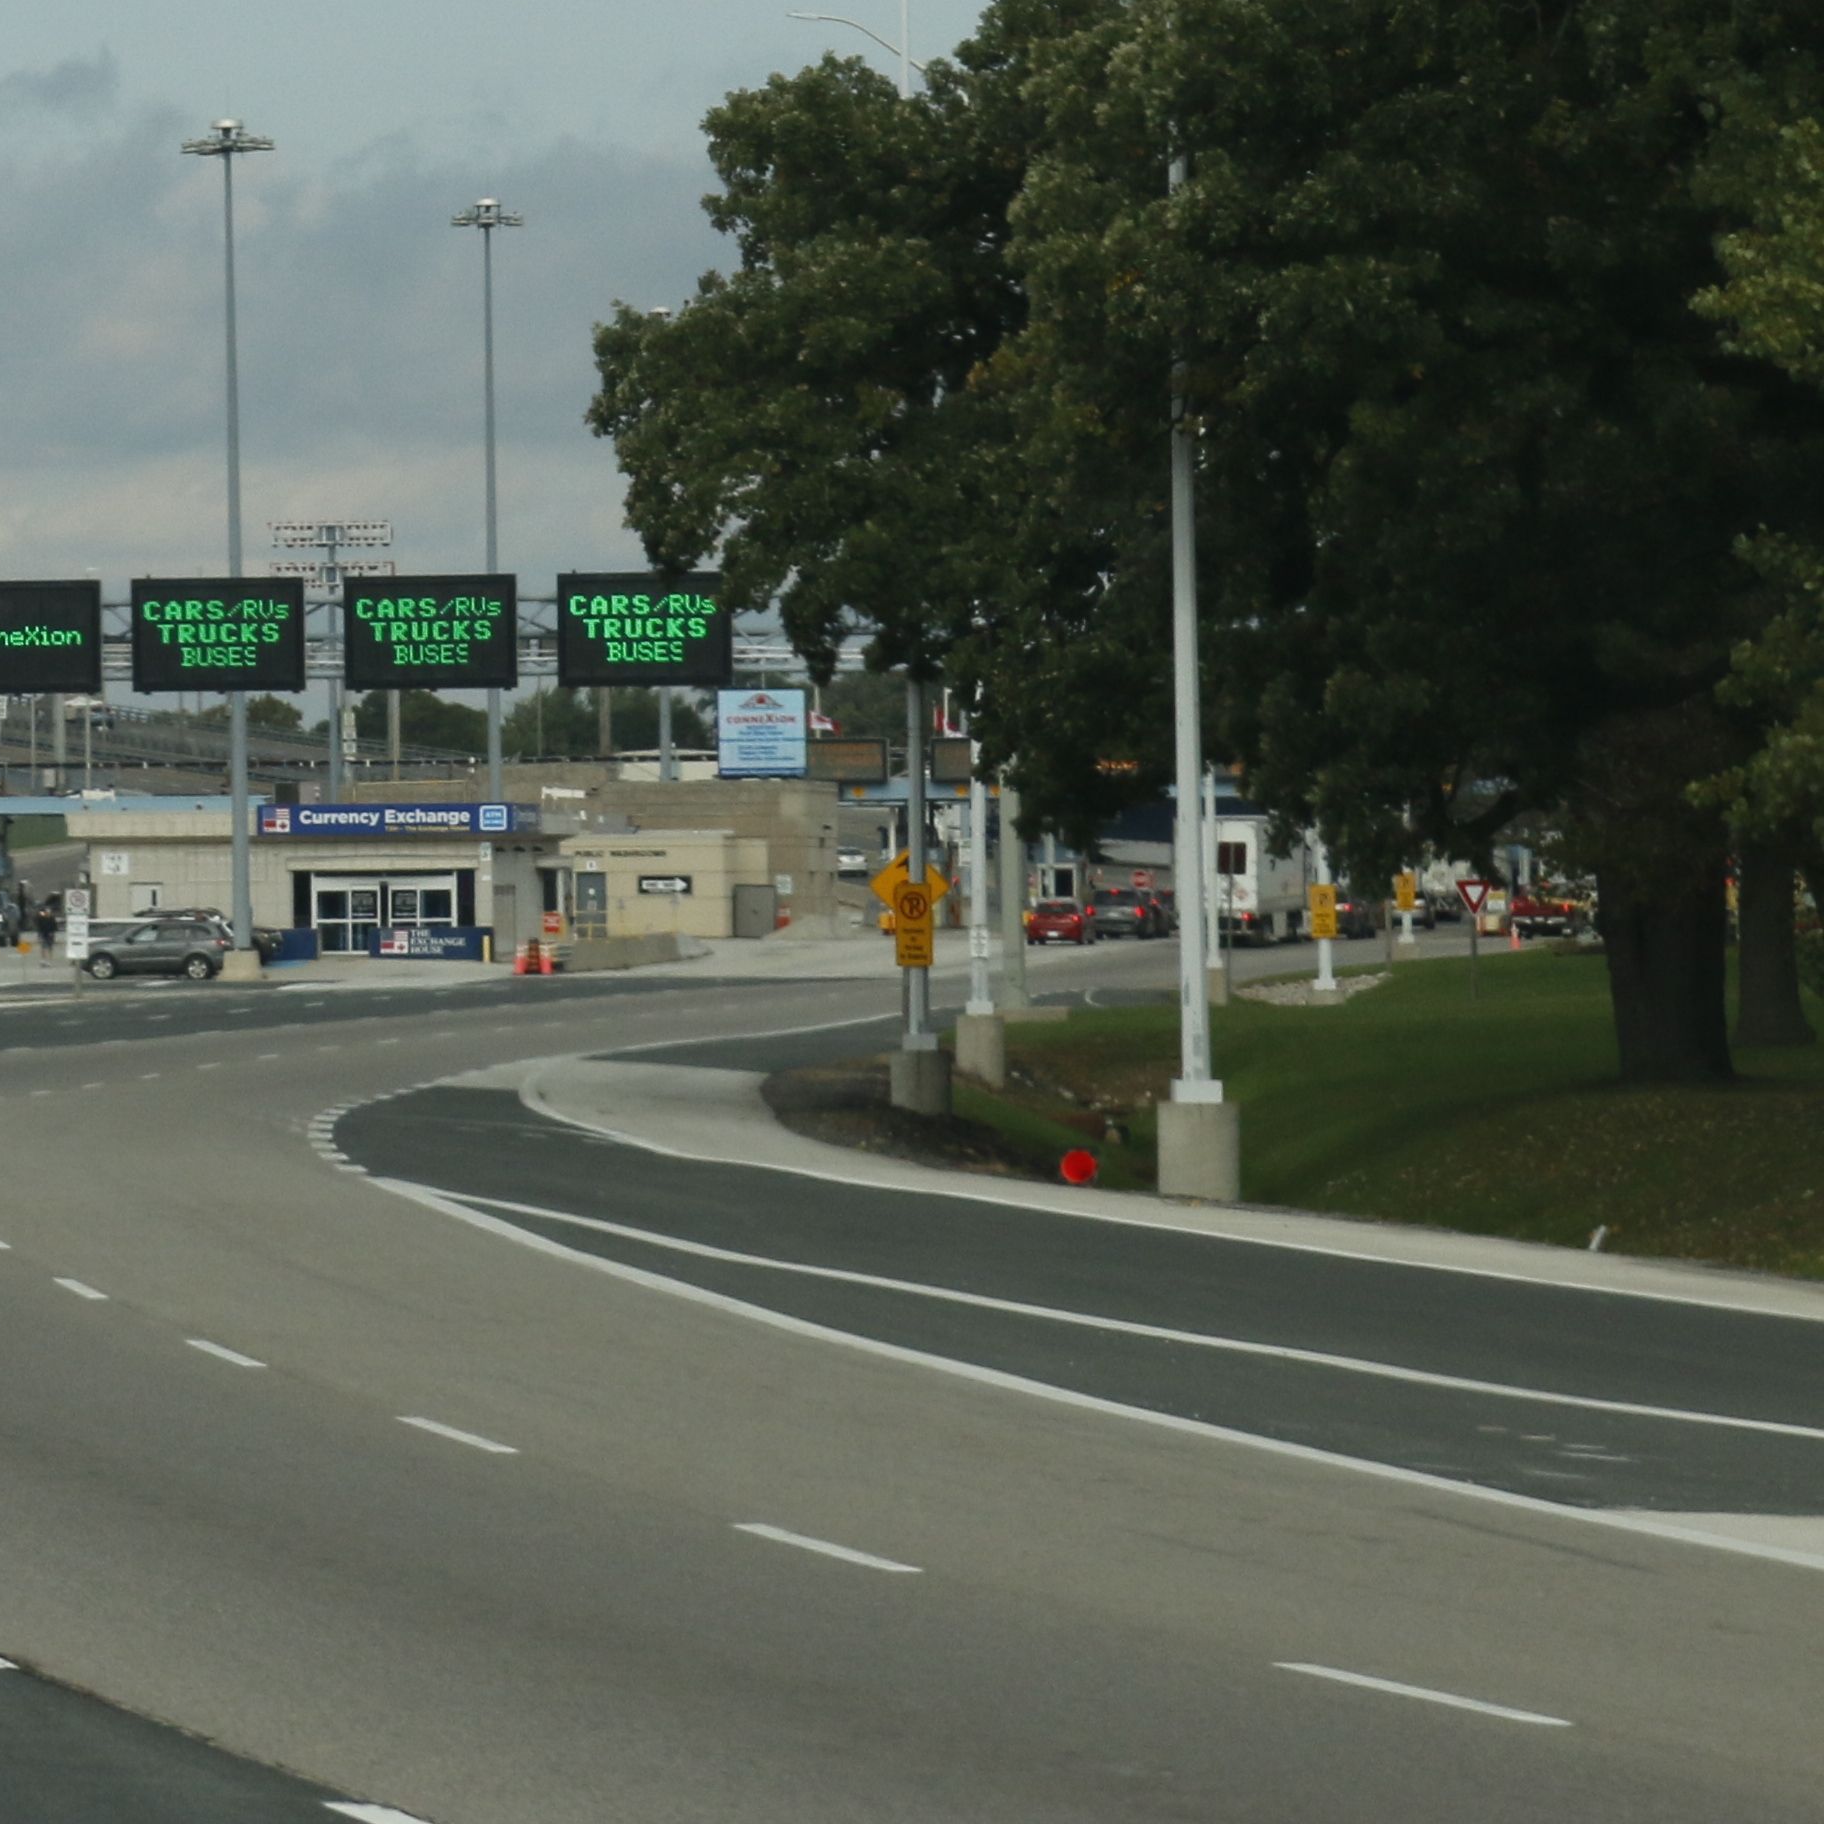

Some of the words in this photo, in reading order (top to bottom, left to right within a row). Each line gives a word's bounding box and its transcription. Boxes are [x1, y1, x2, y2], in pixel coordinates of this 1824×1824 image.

[157, 624, 279, 643] TRUCKS
[369, 621, 492, 642] TRUCKS
[583, 618, 707, 638] TRUCKS
[181, 647, 256, 667] BUSES
[394, 644, 468, 664] BUSES
[607, 641, 683, 662] BUSES
[299, 809, 379, 827] Currency
[384, 808, 470, 825] Exchange
[410, 929, 431, 937] THE
[410, 938, 466, 946] EXCHANGE
[410, 945, 443, 954] HOUSE
